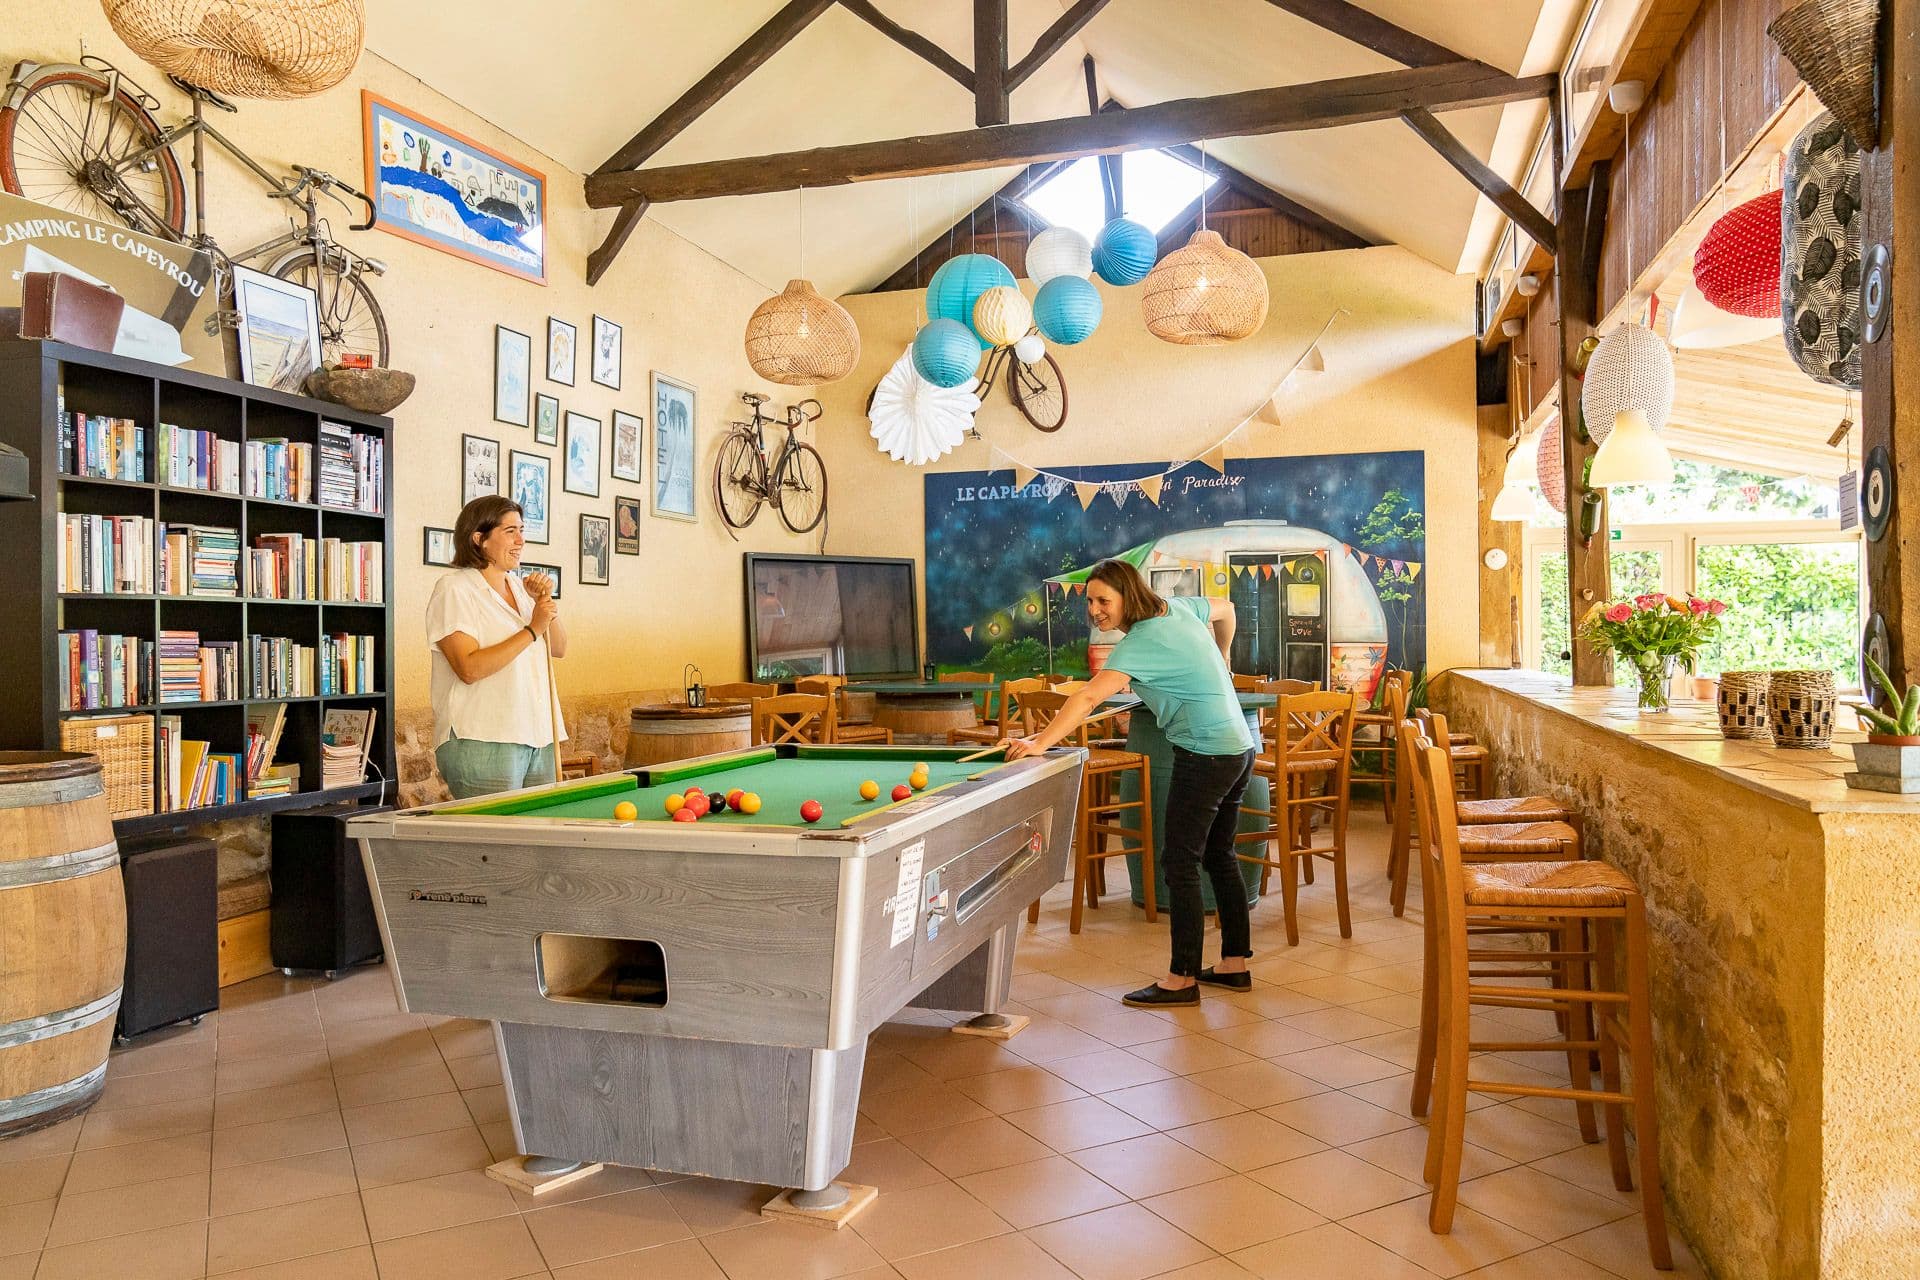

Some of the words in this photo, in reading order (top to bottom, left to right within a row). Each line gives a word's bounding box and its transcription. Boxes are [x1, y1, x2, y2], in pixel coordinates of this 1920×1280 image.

[0, 219, 81, 246] CAMPING
[84, 223, 107, 244] LE
[112, 232, 205, 297] CAPEYROU
[657, 391, 667, 484] HOTEL
[957, 487, 974, 502] LE
[1181, 475, 1245, 495] Paradise
